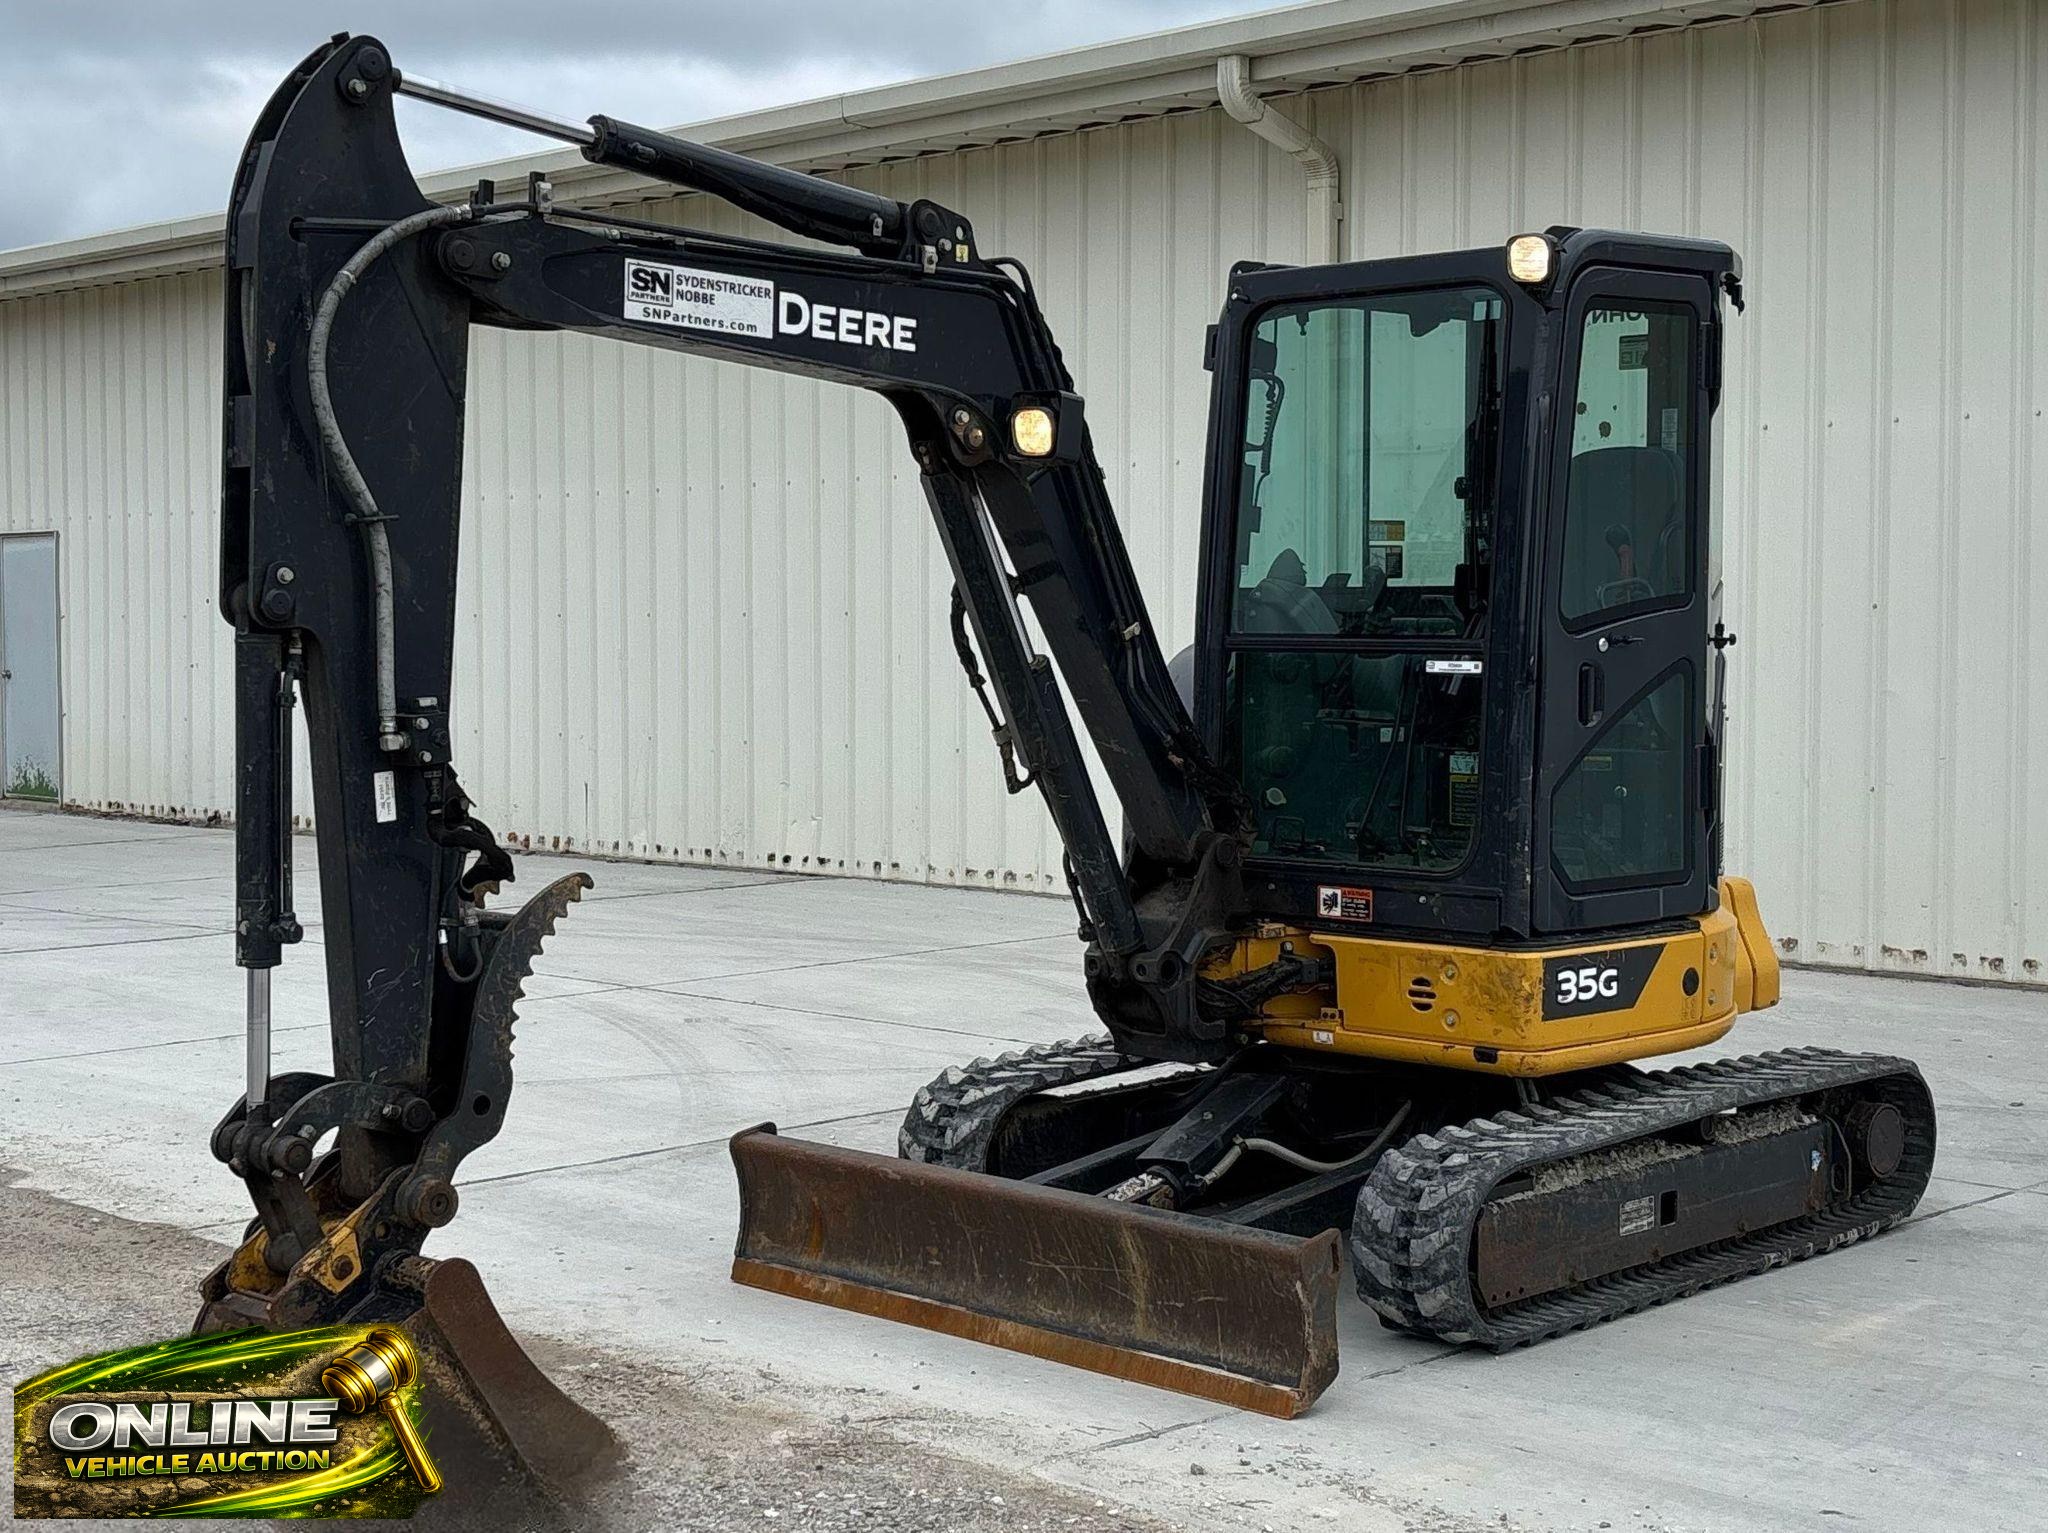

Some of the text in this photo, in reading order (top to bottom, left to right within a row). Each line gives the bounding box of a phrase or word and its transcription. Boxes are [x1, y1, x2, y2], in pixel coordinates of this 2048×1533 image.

[632, 267, 670, 295] SN
[676, 274, 772, 299] SYDENSTRICKER
[631, 291, 670, 303] PARTNERS
[676, 289, 716, 305] NOBBE
[642, 306, 757, 333] SNPartners.com
[778, 290, 917, 352] DEERE
[1557, 967, 1618, 1004] 35G
